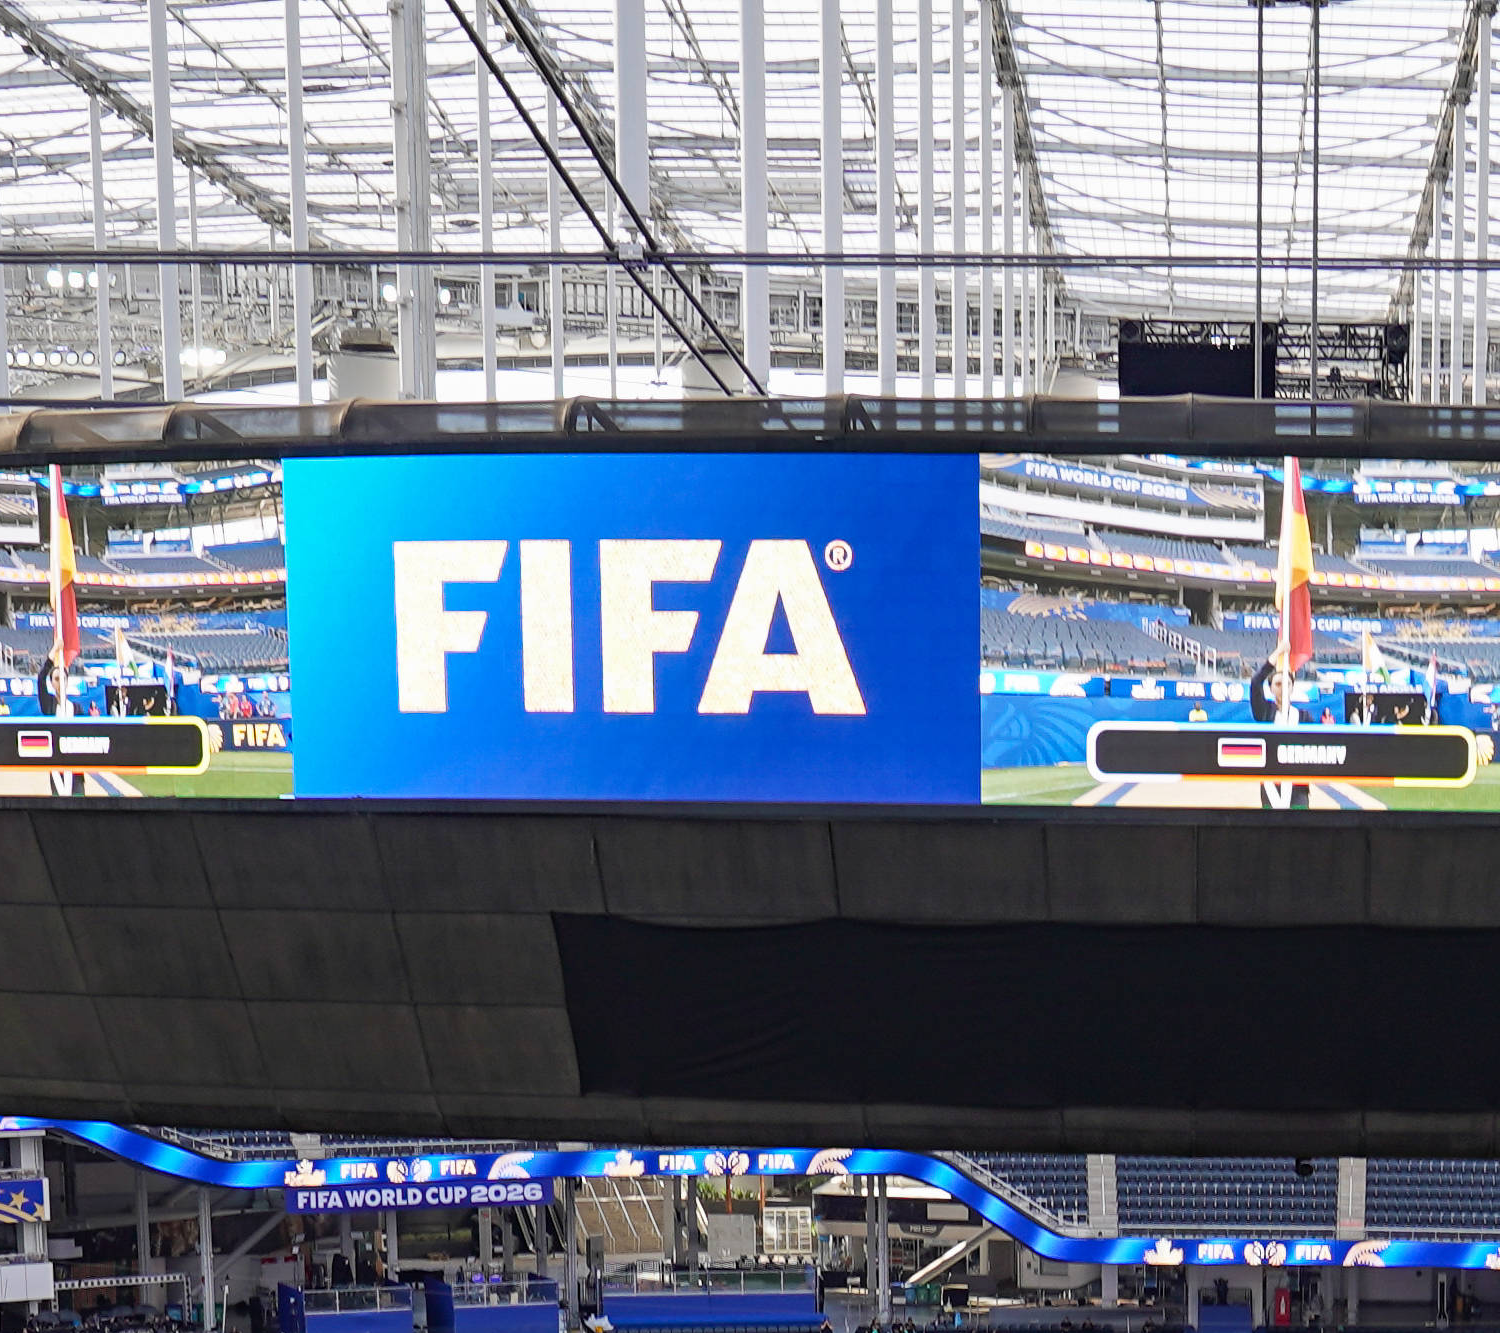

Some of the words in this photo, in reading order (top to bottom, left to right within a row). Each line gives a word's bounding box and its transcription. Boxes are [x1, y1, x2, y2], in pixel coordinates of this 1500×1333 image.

[1026, 462, 1058, 479] FIFA
[1059, 468, 1111, 488] WORLD
[1113, 473, 1140, 493] CUP
[233, 724, 286, 747] FIFA
[1278, 745, 1346, 764] GERMANY
[440, 1159, 476, 1176] FIFA
[659, 1155, 696, 1170] FIFA
[758, 1154, 795, 1169] FIFA
[340, 1163, 378, 1179] FIFA
[298, 1191, 343, 1209] FIFA
[346, 1188, 427, 1207] WORLD
[430, 1187, 467, 1204] CUP
[471, 1184, 542, 1202] 2026
[1198, 1244, 1234, 1259] FIFA
[1296, 1245, 1331, 1260] FIFA
